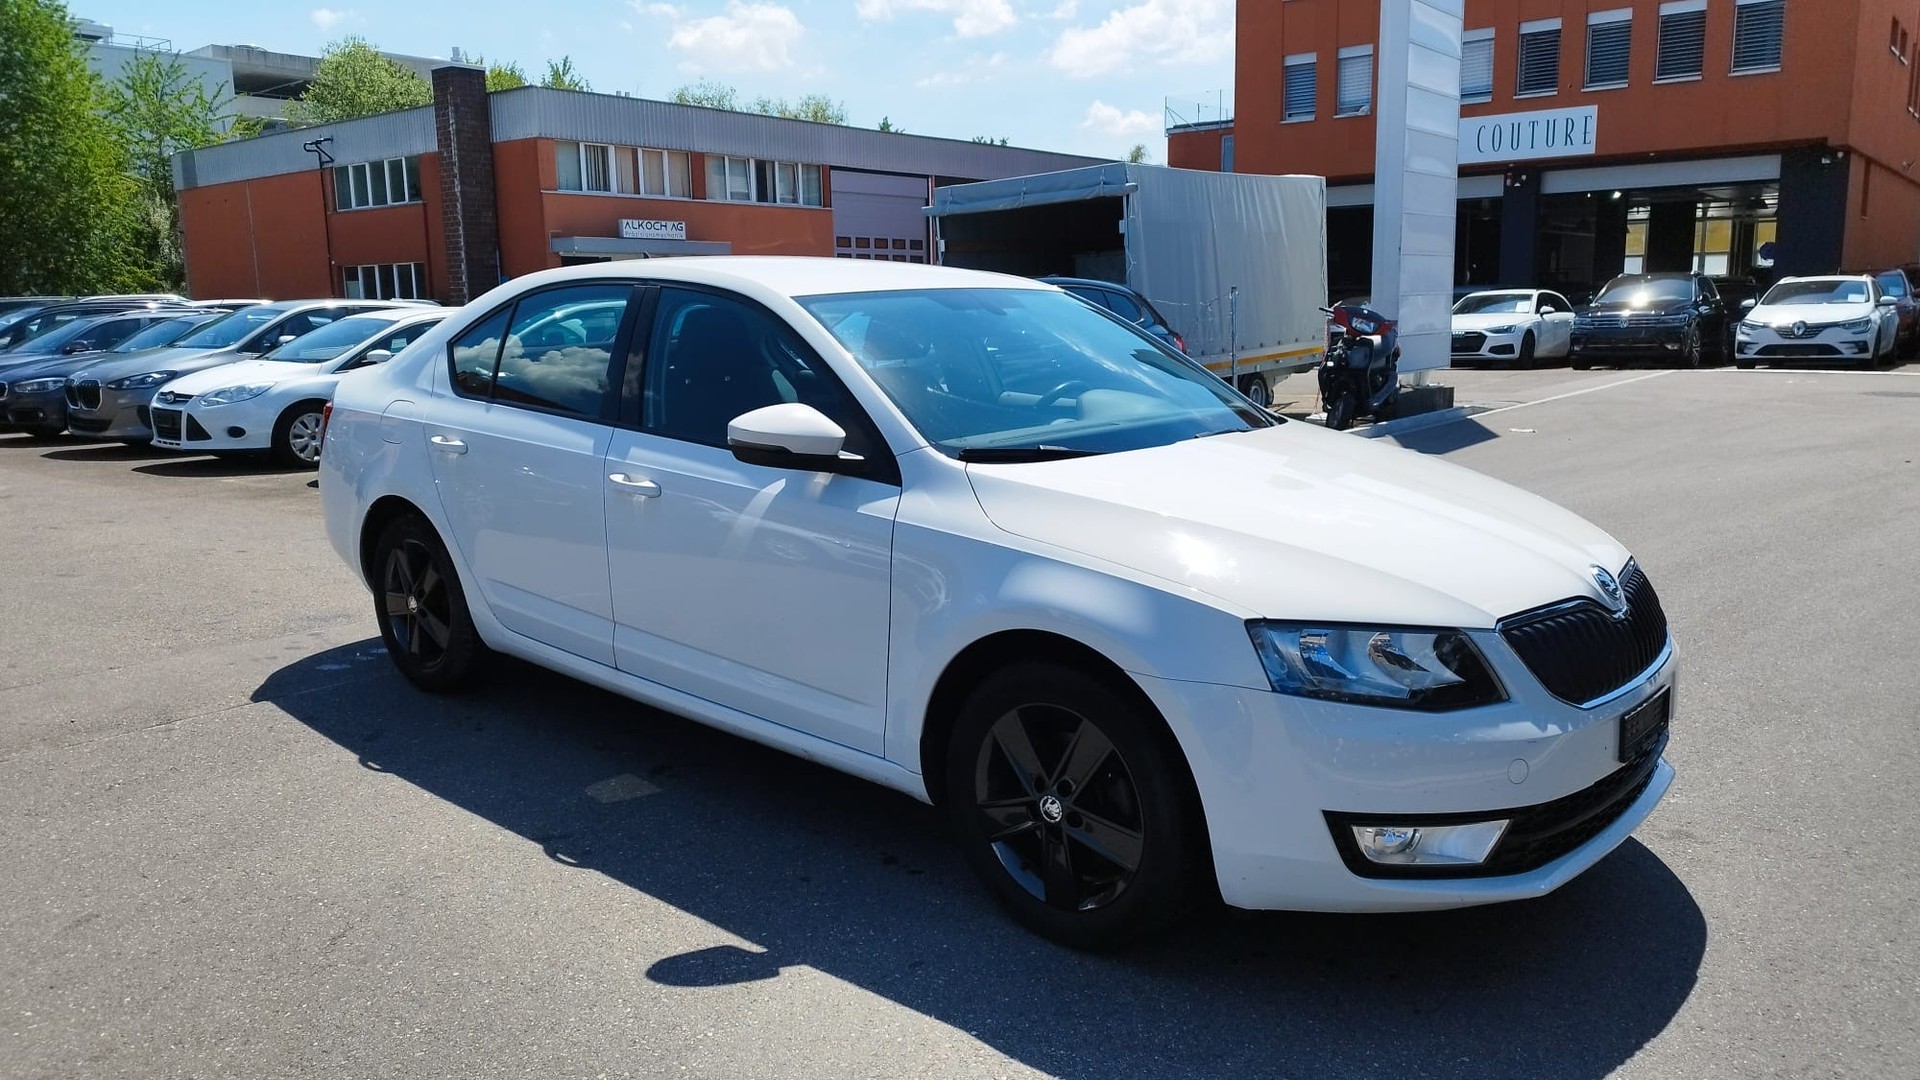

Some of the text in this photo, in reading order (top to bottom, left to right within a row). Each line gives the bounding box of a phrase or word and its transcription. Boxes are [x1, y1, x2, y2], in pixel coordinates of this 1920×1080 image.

[1476, 115, 1593, 153] COUTURE
[624, 220, 684, 232] ALKOCH AG
